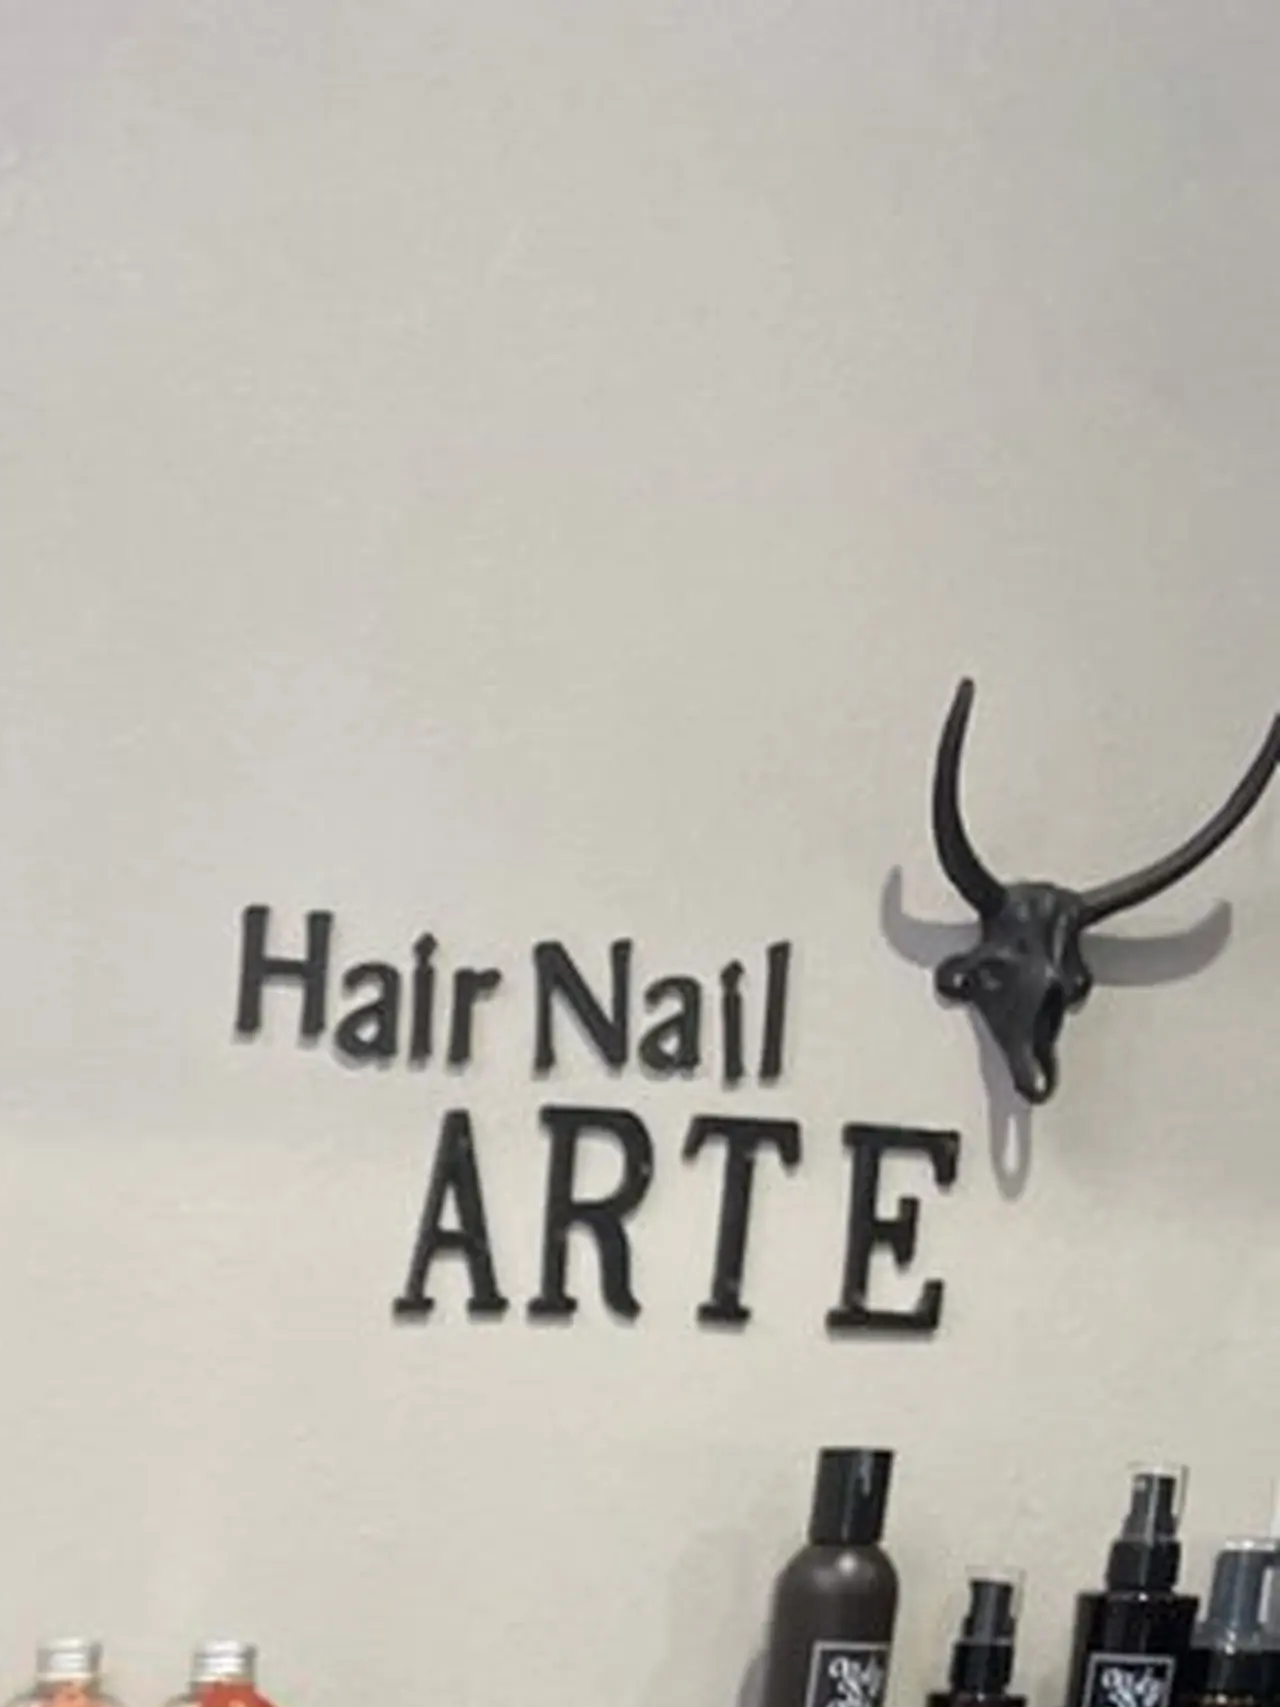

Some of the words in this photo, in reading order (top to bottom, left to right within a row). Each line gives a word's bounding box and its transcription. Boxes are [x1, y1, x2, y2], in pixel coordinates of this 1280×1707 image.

[235, 904, 502, 1066] Hair
[532, 937, 793, 1084] Nail
[391, 1105, 961, 1331] ARTE
